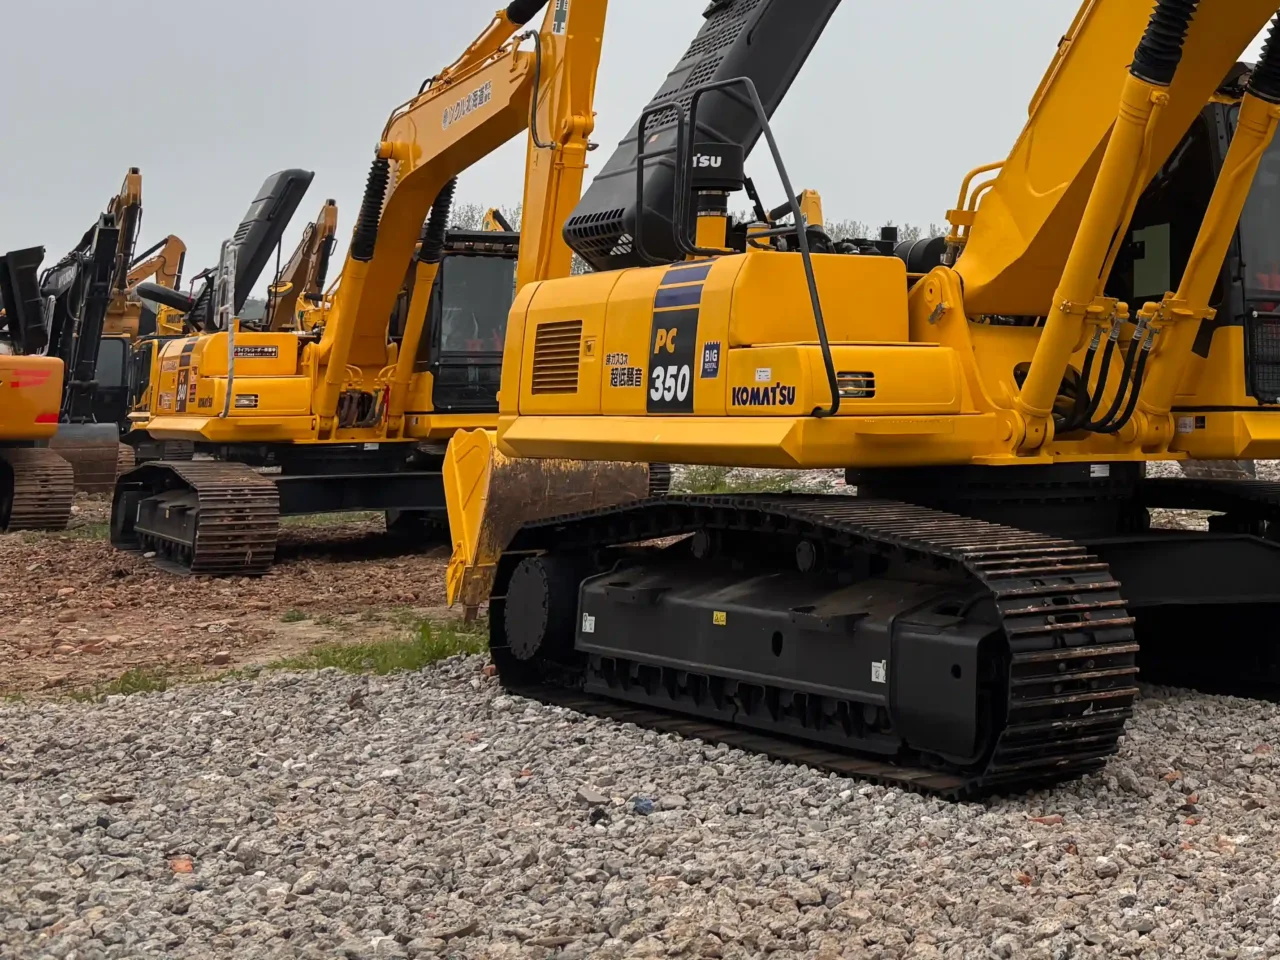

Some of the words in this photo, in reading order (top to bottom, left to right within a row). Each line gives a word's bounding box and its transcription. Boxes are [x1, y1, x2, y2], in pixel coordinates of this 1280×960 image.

[653, 327, 678, 354] PC
[704, 349, 718, 362] BIG
[650, 364, 690, 402] 350
[732, 382, 796, 406] KOMATSU
